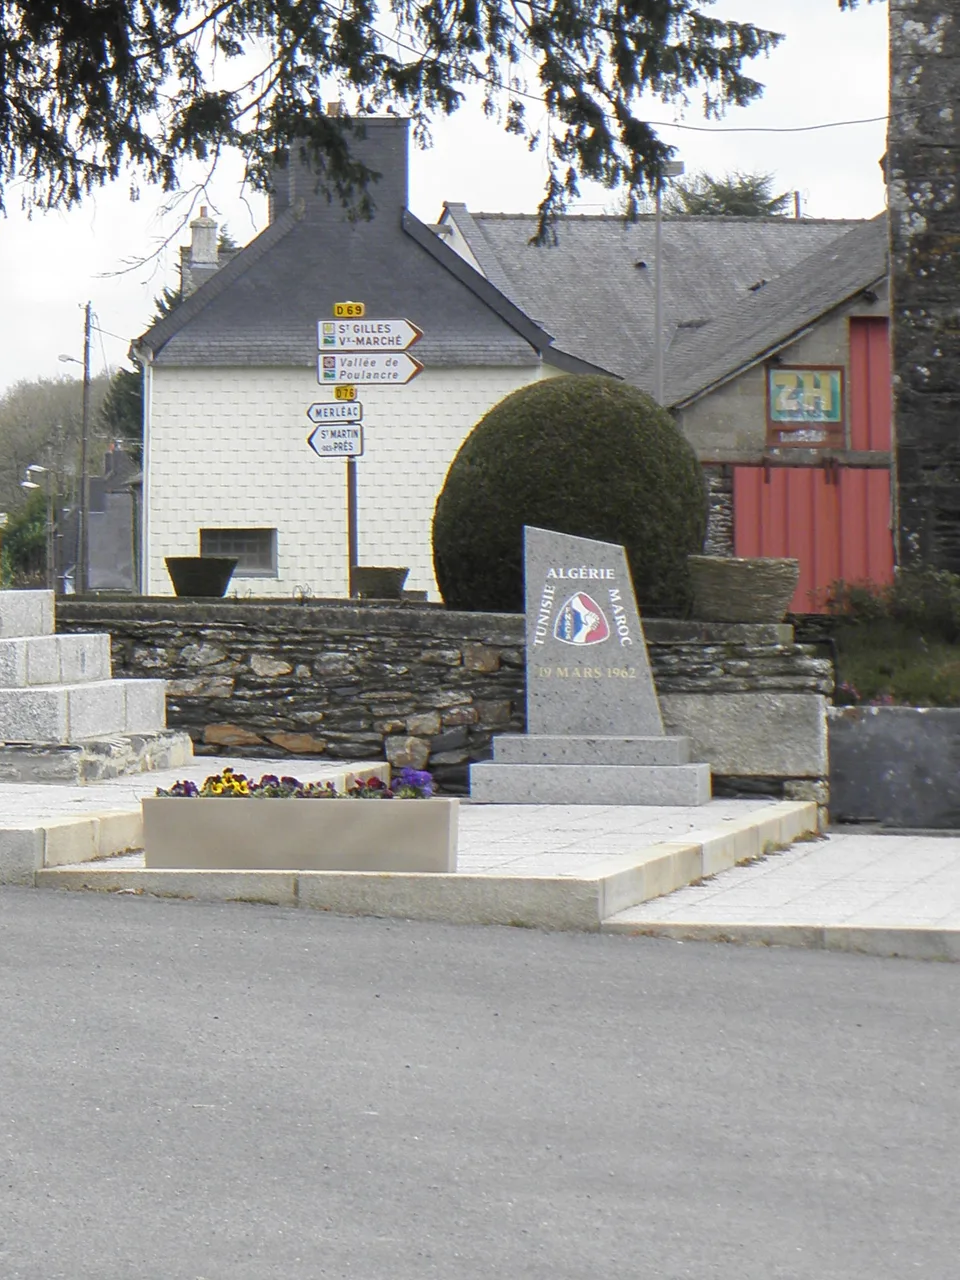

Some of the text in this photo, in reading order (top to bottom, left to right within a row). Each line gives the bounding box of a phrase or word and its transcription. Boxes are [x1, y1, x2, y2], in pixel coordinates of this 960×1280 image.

[336, 305, 362, 315] D 69
[353, 323, 392, 334] GILLES
[340, 357, 399, 368] Vallée de
[339, 370, 400, 380] Poulancre
[336, 388, 355, 398] D 76
[315, 405, 359, 418] MERLÉAC
[330, 428, 359, 439] MARTIN
[546, 565, 616, 580] ALGÉRIE
[533, 584, 557, 646] TUNISIE
[608, 588, 633, 648] MAROC
[539, 667, 637, 679] 19 MARS 1962
